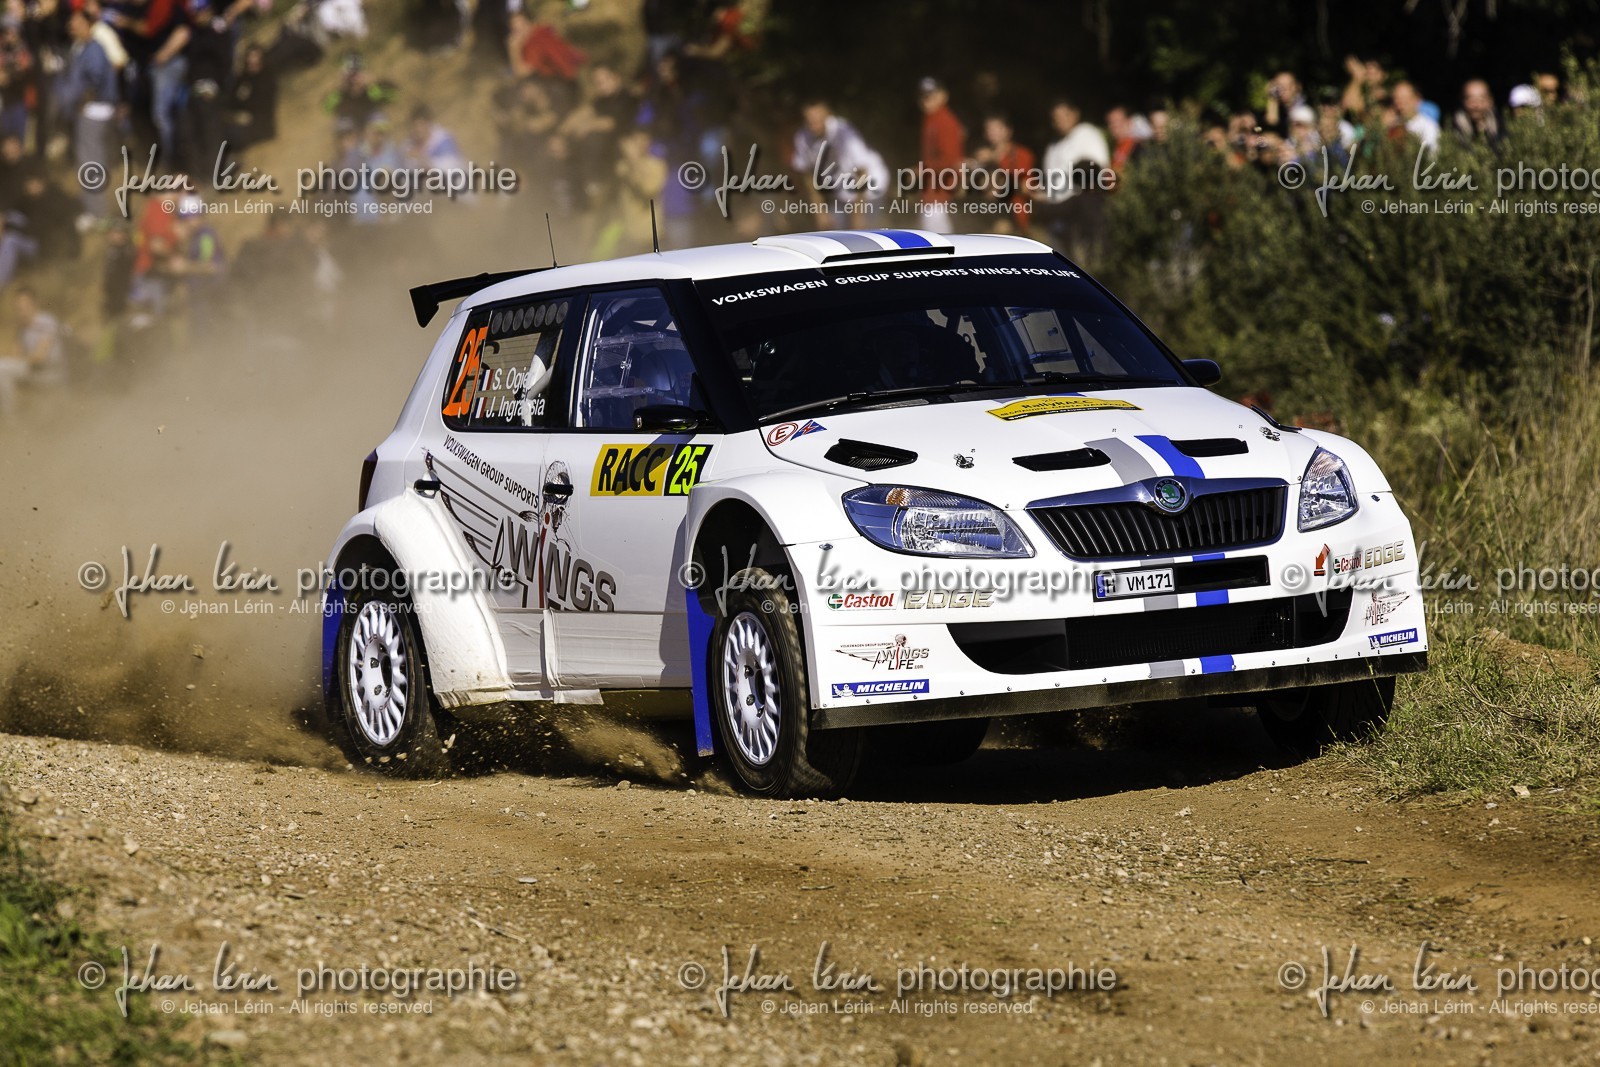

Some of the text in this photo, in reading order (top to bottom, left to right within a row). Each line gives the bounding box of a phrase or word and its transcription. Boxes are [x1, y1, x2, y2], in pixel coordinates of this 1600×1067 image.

[712, 267, 1080, 306] VOLKSWAGEN GROUP SUPPORTS WINGS FOR LIFE
[442, 326, 489, 416] 25
[492, 366, 530, 395] S. Ogie
[486, 396, 496, 418] J.
[444, 435, 540, 509] VOLKSWAGEN GROUP SUPPORTS
[597, 447, 666, 492] RACC
[668, 445, 707, 495] 25
[507, 516, 617, 612] WINGS
[1341, 540, 1406, 572] Castrol EDGE
[844, 593, 895, 608] Castrol
[903, 589, 996, 609] EDGE
[1380, 631, 1415, 644] MICHELIN
[882, 648, 930, 660] WINGS
[888, 660, 915, 670] LIFE
[856, 681, 926, 693] MICHELIN
